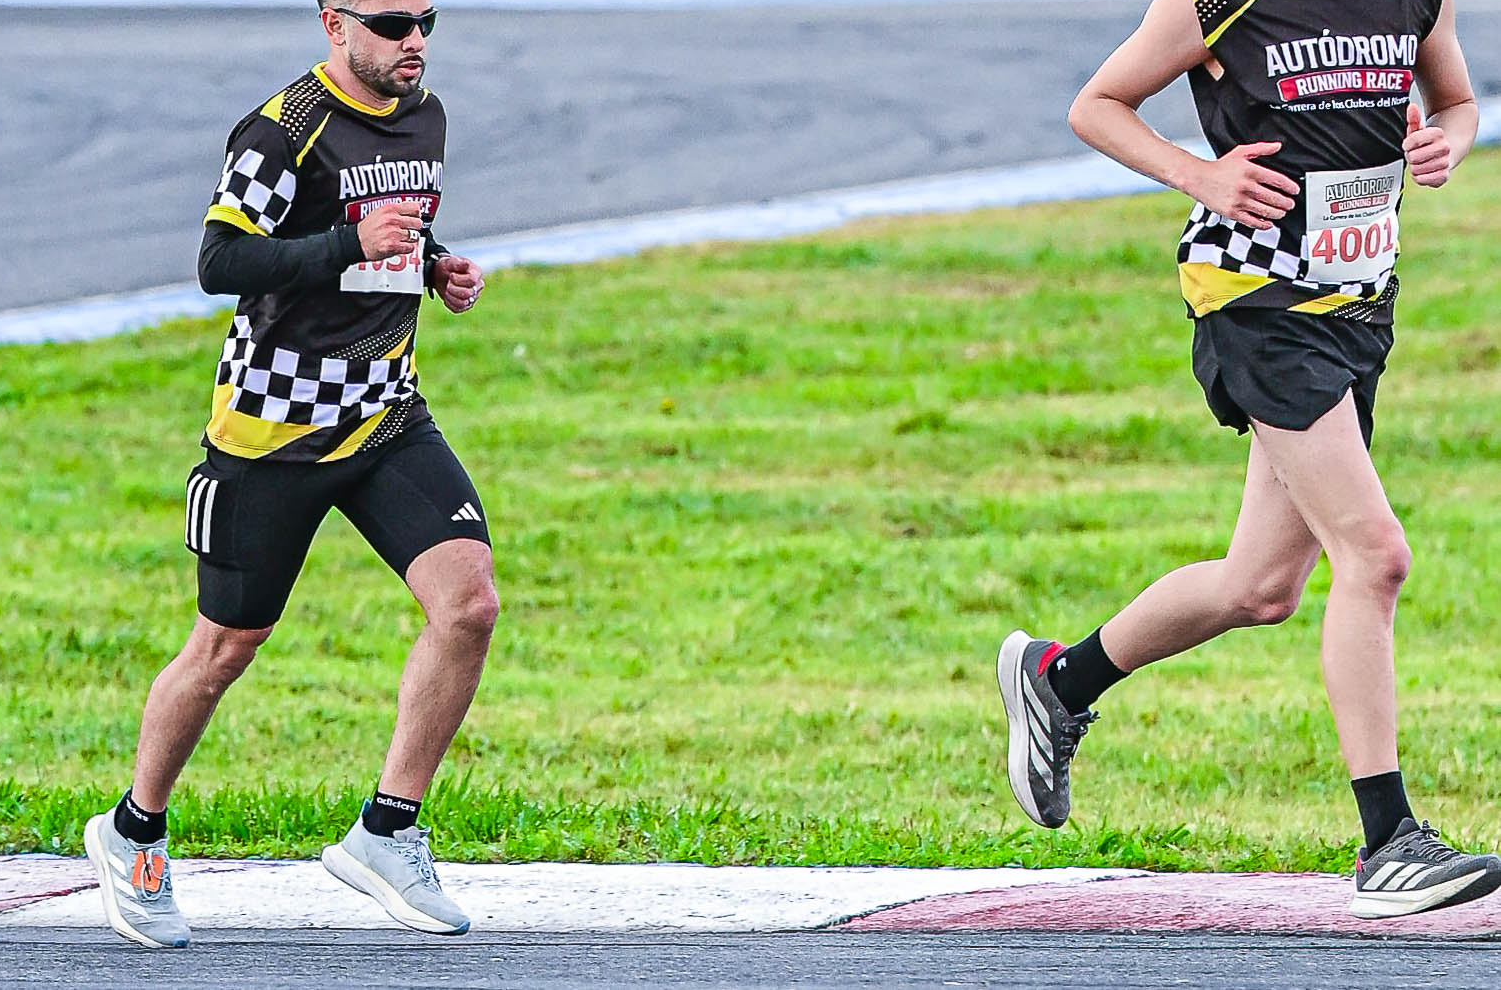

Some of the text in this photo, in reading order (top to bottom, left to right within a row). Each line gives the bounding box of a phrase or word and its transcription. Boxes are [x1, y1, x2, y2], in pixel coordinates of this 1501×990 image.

[1264, 28, 1417, 77] AUTÓDROMO
[1296, 73, 1404, 96] RUNNING RACE
[1319, 100, 1331, 109] de
[338, 155, 443, 200] AUTÓDROMO
[1312, 217, 1393, 264] 4001
